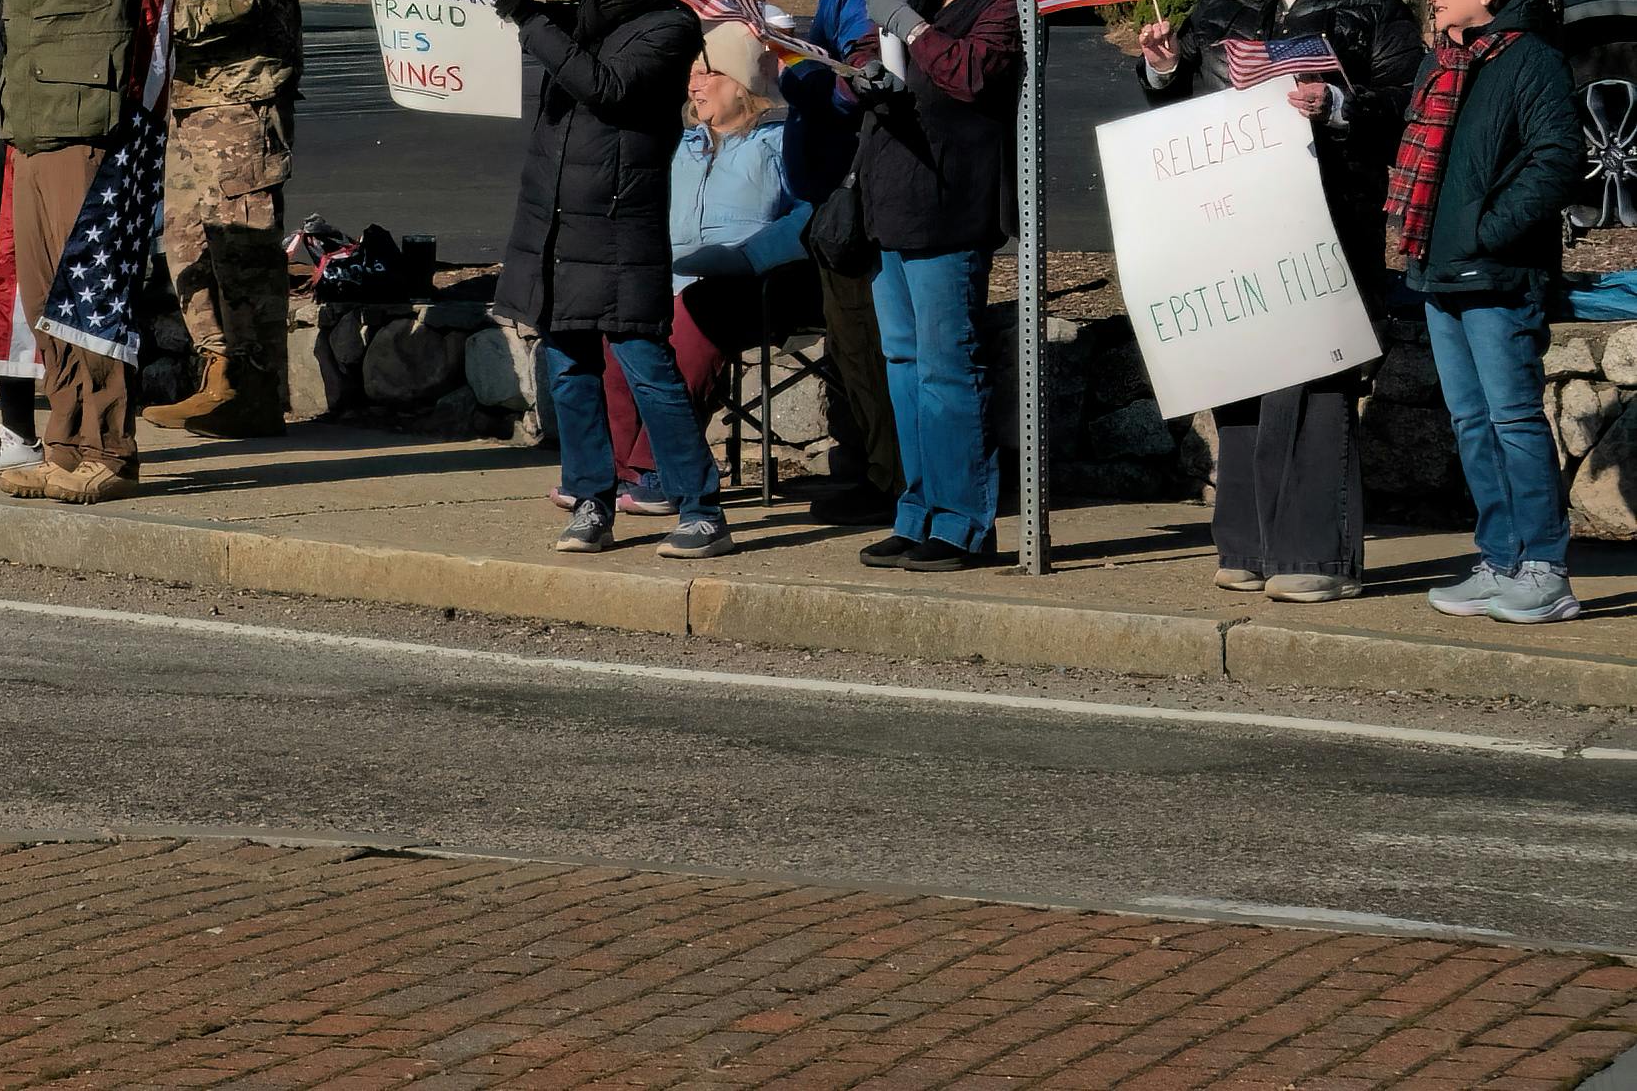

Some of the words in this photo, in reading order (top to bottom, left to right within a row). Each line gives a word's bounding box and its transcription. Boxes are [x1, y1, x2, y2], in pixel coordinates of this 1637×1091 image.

[380, 25, 431, 52] LIES
[385, 55, 464, 92] KINGS
[1152, 107, 1283, 181] RELEASE
[1200, 194, 1236, 223] THE
